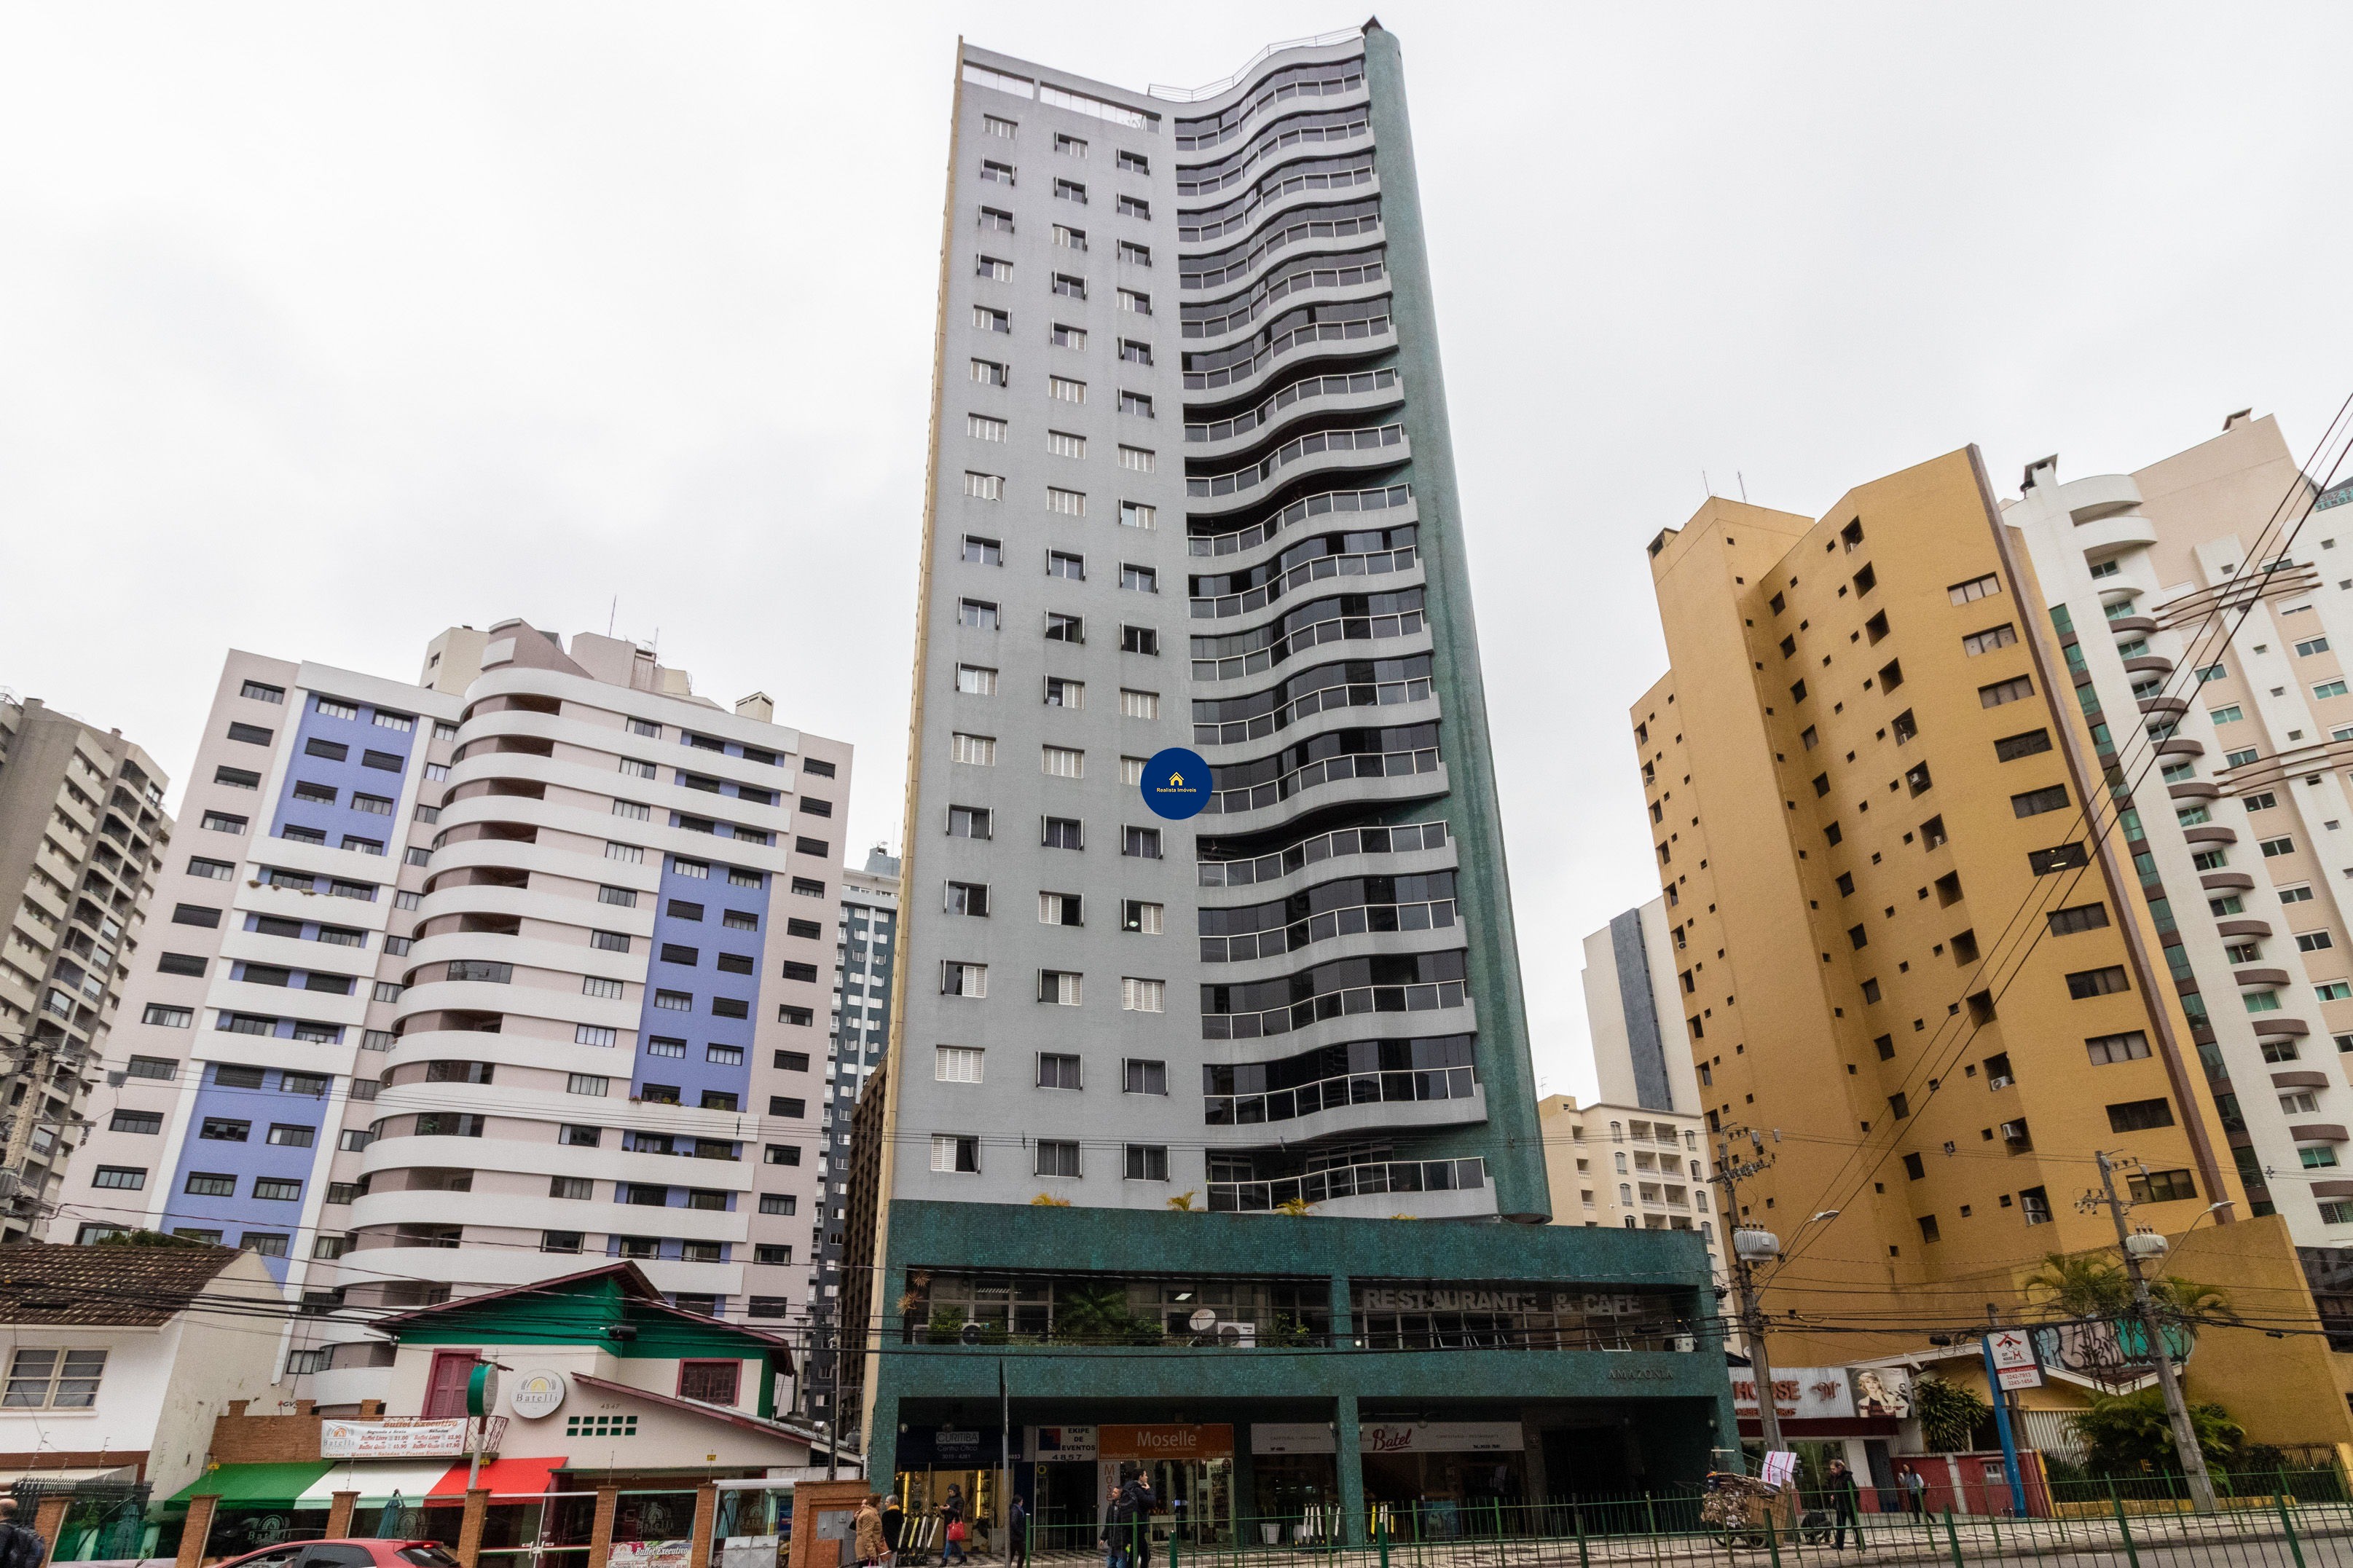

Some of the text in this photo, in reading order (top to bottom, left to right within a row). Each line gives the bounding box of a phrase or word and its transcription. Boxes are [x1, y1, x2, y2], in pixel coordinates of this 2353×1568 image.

[1365, 1289, 1539, 1312] RESTAURANTE
[1556, 1293, 1573, 1312] &
[2013, 1350, 2023, 1360] M
[1733, 1380, 1802, 1400] HOSE
[516, 1393, 558, 1402] Batelli
[413, 1419, 457, 1427] Executivo
[937, 1433, 978, 1442] CURITIBA
[1137, 1430, 1197, 1447] Moselle
[1372, 1428, 1413, 1451] Batel
[635, 1547, 656, 1556] Buffet
[656, 1546, 688, 1556] Executivo
